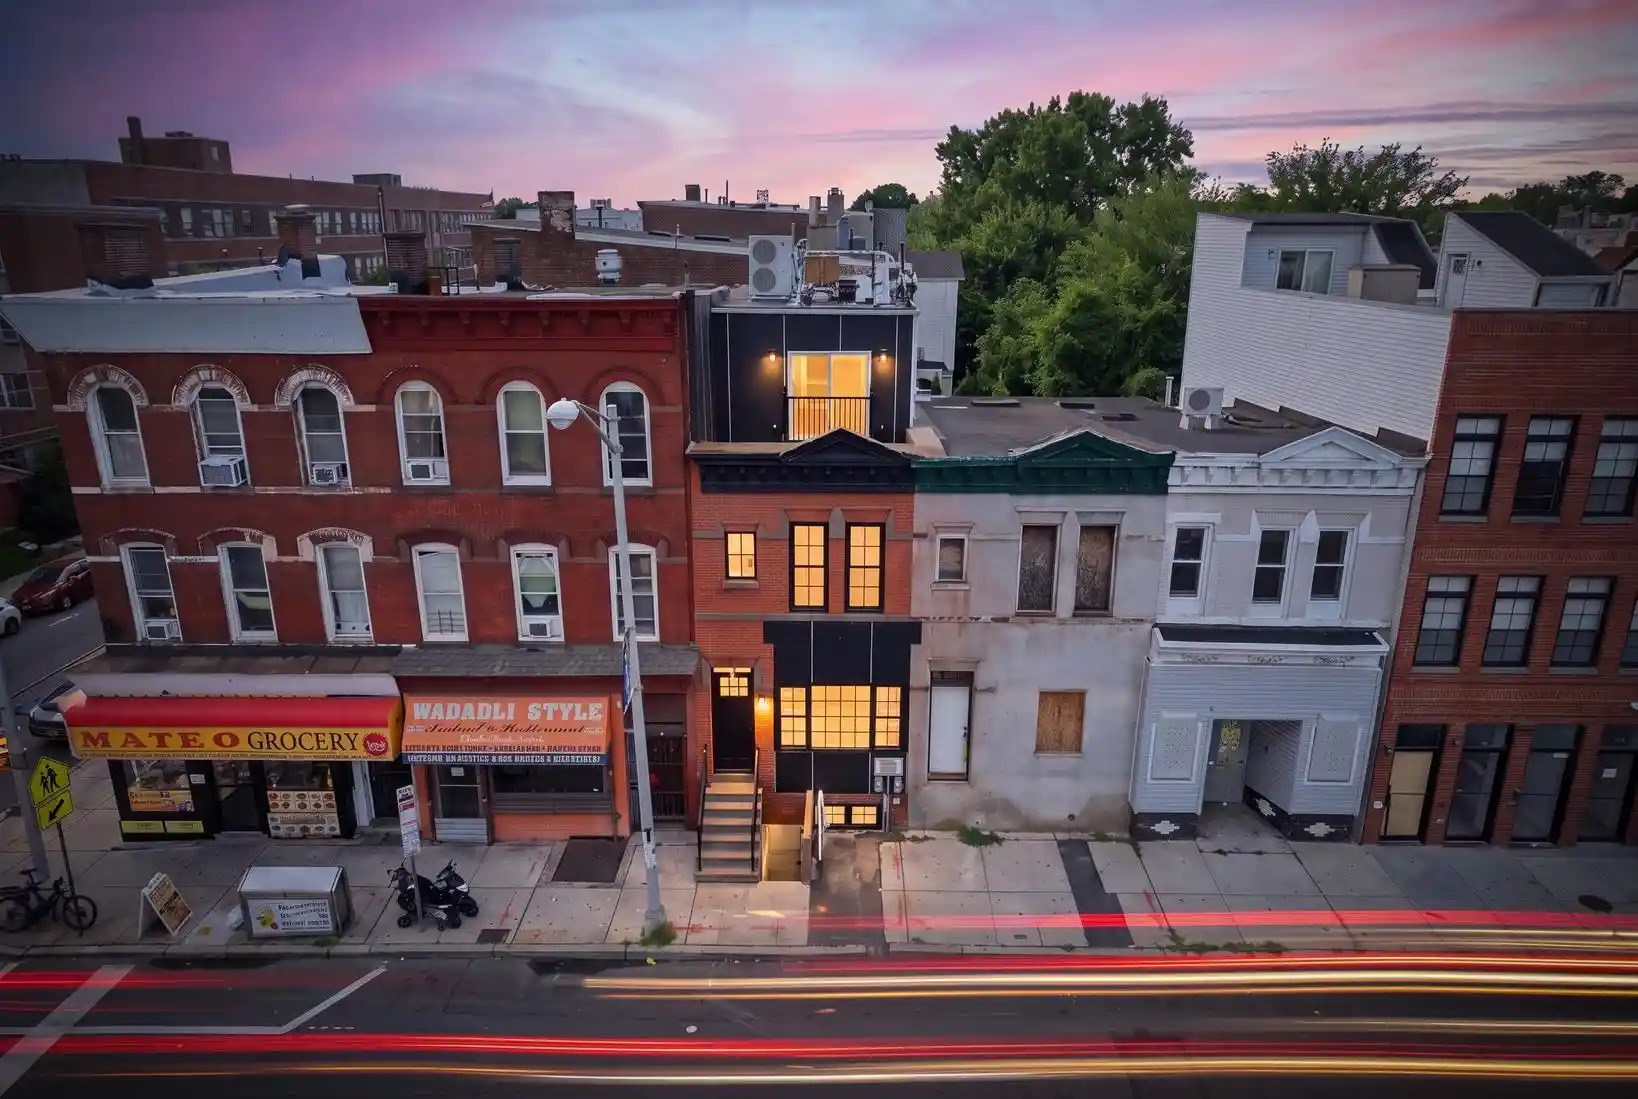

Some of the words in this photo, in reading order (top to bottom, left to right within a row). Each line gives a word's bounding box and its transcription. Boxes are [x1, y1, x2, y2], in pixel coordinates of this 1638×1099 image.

[413, 702, 515, 721] WADADLI
[528, 702, 603, 722] STYLE
[81, 731, 240, 749] MATEO
[247, 731, 359, 751] GROCERY
